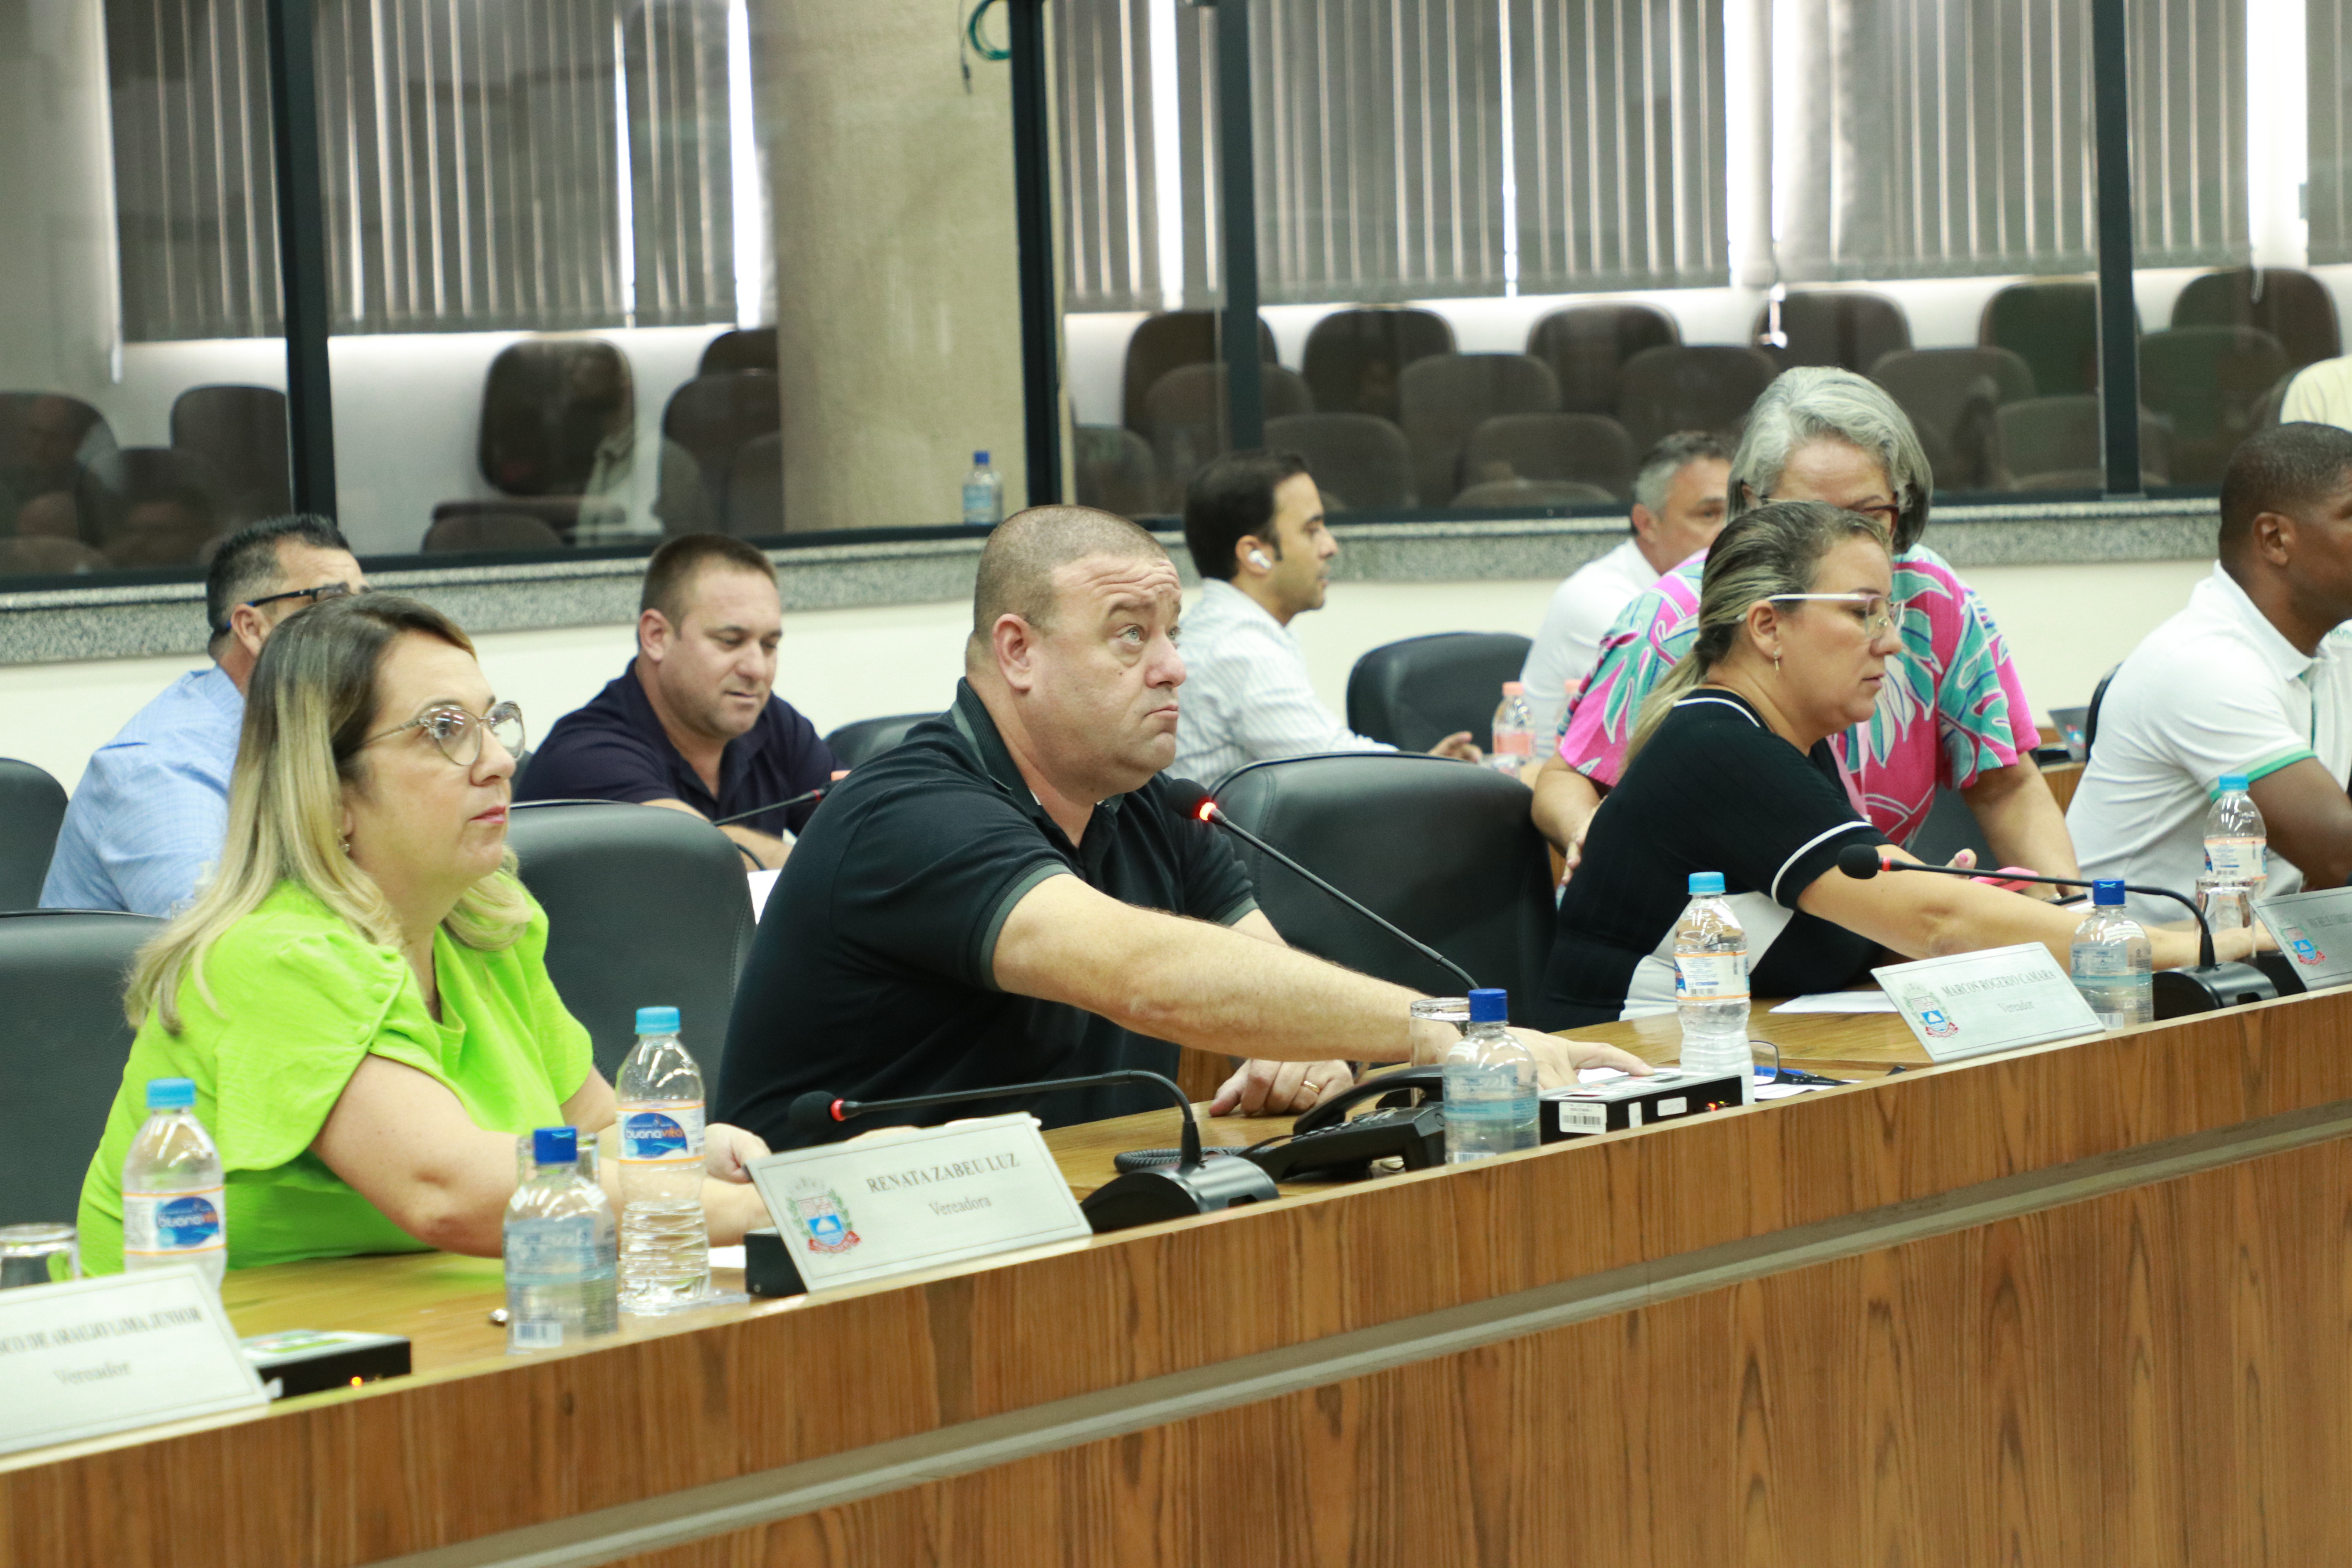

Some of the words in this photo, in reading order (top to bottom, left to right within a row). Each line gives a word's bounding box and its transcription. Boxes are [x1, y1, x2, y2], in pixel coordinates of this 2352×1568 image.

[1942, 981, 1979, 996] MARCOS
[1979, 975, 2020, 991] ROGERIO
[1998, 1000, 2034, 1013] Vereador
[866, 1170, 932, 1192] RENATA
[931, 1160, 985, 1181] ZABEU
[986, 1153, 1020, 1171] LUZ
[929, 1197, 992, 1216] Vereadora
[54, 1359, 131, 1385] Vereador
